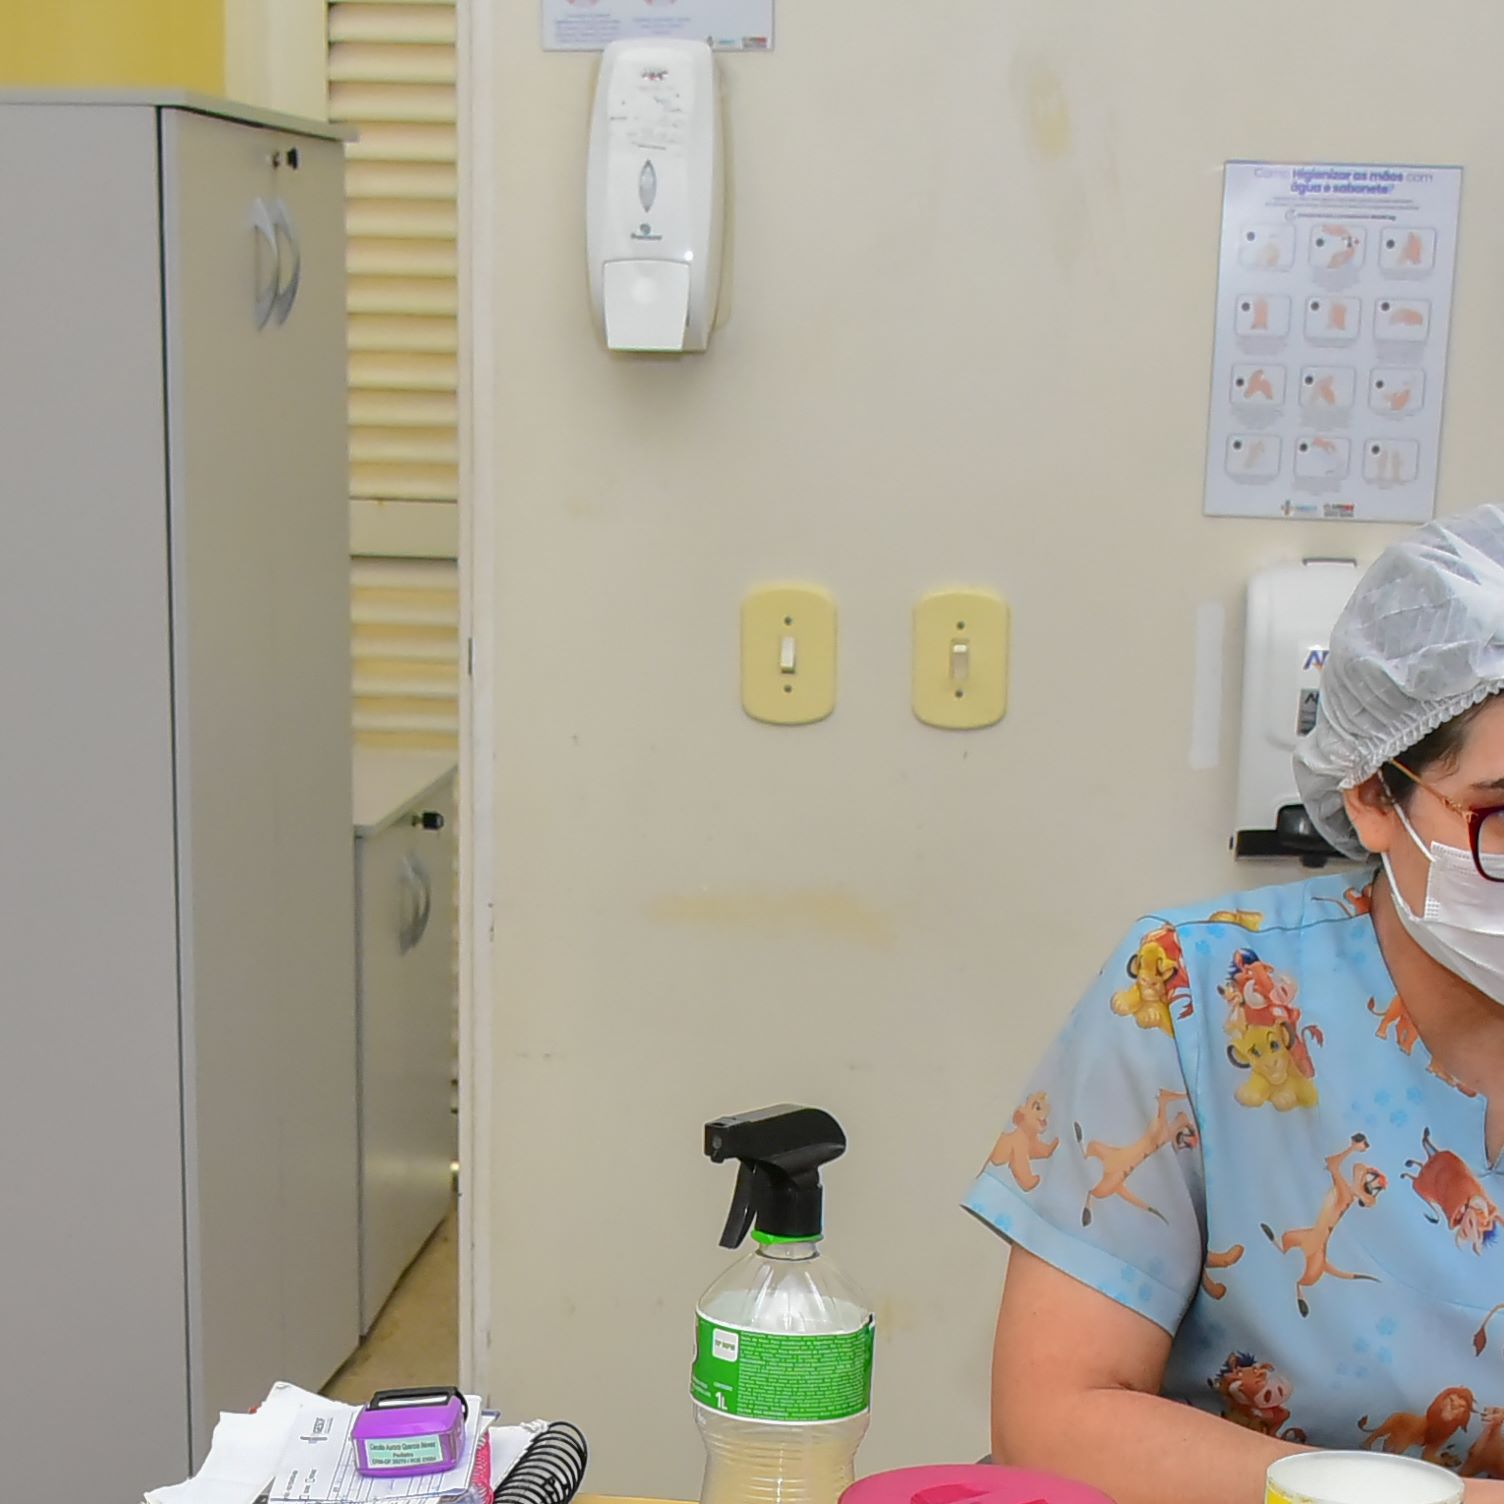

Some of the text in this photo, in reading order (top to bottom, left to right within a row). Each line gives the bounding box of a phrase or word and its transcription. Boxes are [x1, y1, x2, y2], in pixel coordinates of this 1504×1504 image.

[1293, 168, 1351, 183] Higienizar
[1369, 169, 1404, 182] mãos
[1405, 173, 1433, 183] com
[1290, 182, 1322, 196] água
